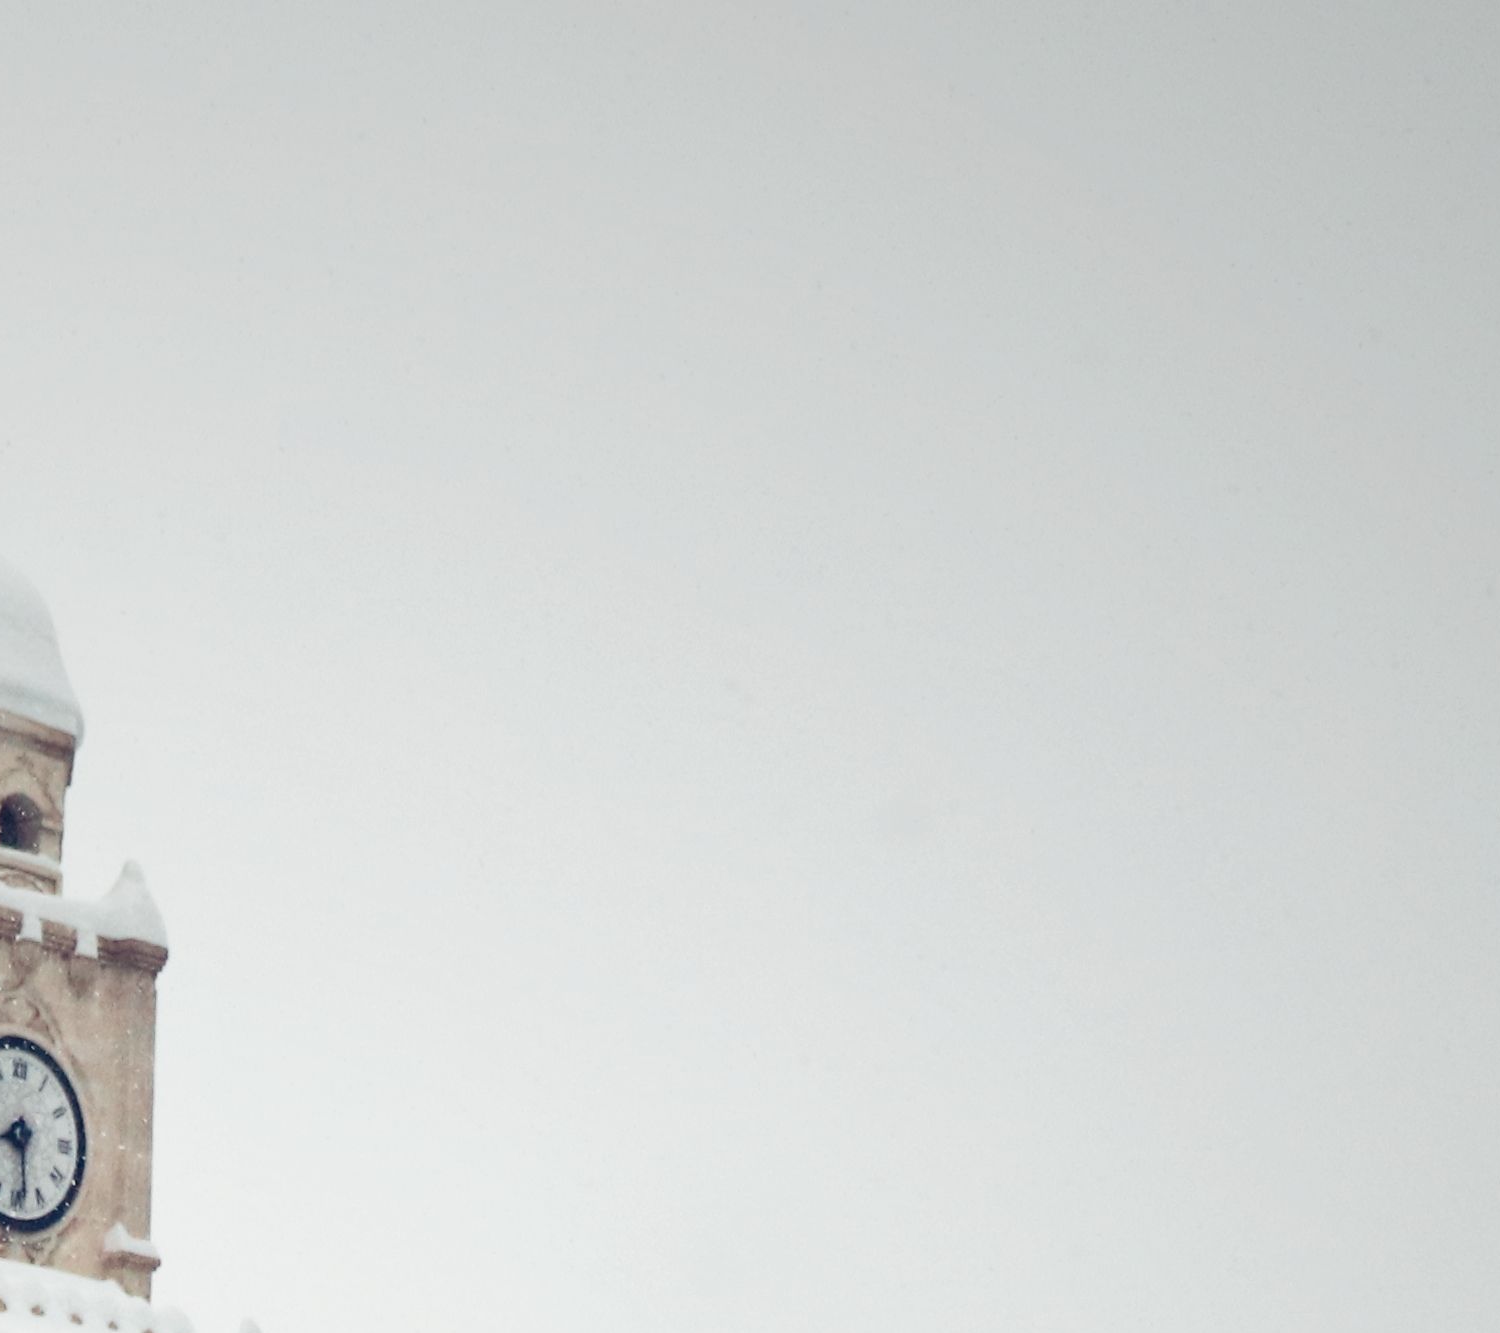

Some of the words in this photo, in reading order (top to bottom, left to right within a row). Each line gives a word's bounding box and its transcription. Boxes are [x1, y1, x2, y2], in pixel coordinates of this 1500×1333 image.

[13, 1058, 28, 1080] XII
[58, 1139, 72, 1154] III
[50, 1166, 64, 1187] IV
[35, 1188, 45, 1207] V
